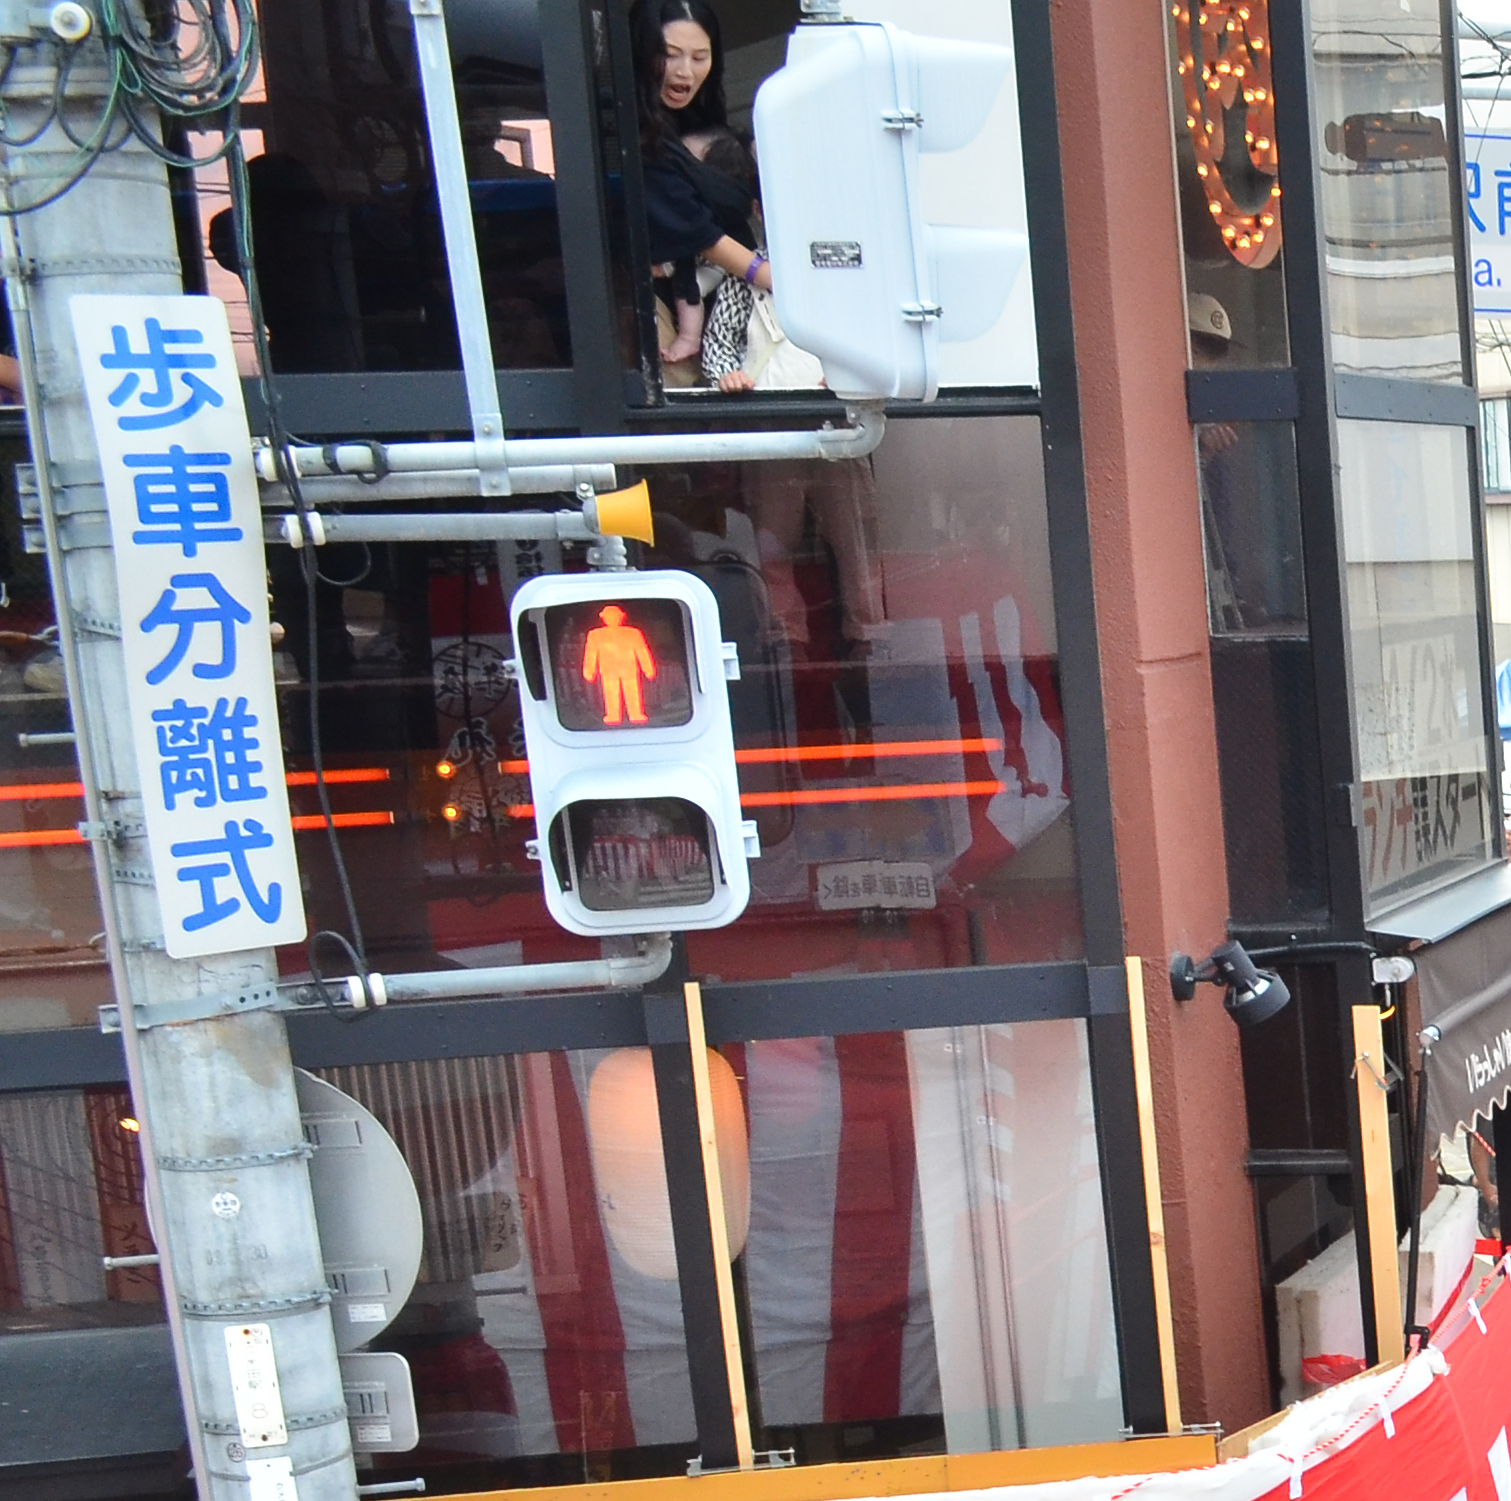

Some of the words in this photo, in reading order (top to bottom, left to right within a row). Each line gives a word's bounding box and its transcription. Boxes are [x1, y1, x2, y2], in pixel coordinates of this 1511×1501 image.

[100, 316, 283, 933] 歩車分離式
